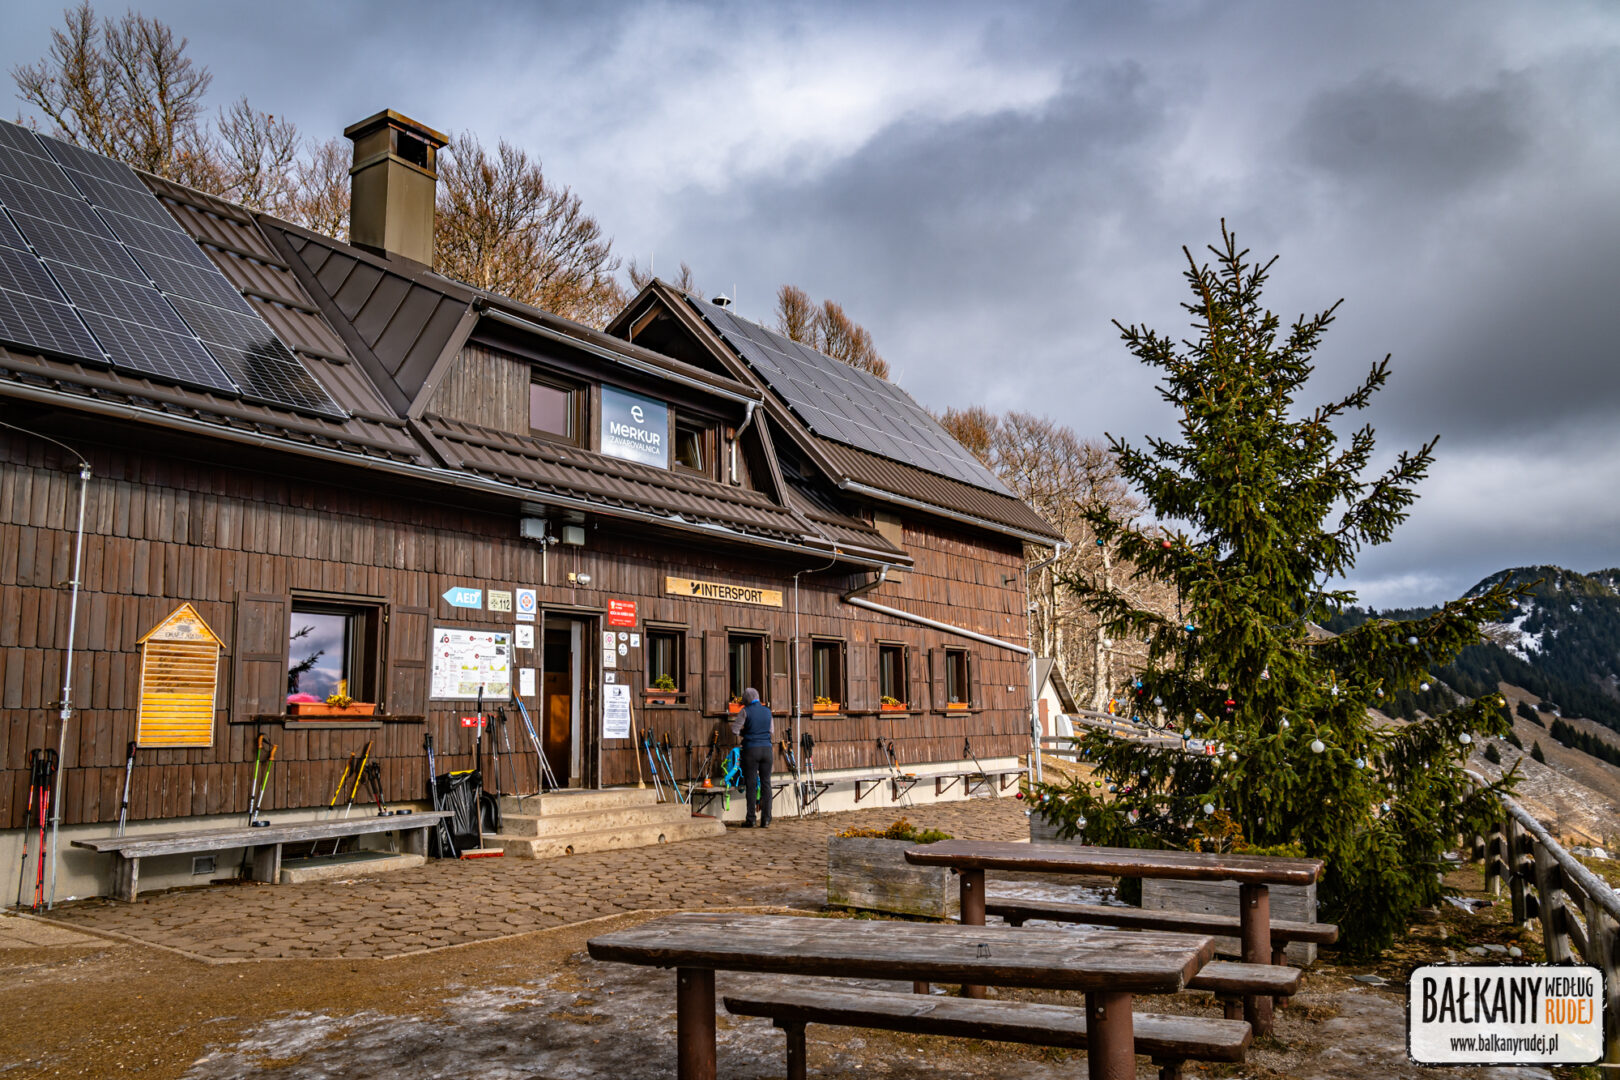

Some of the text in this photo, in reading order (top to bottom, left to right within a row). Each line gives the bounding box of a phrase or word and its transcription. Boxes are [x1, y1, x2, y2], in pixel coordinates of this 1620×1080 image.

[609, 435, 660, 455] ZAVAROVALNICA
[455, 591, 478, 605] AED
[701, 583, 762, 603] INTERSPORT
[499, 599, 511, 610] 112
